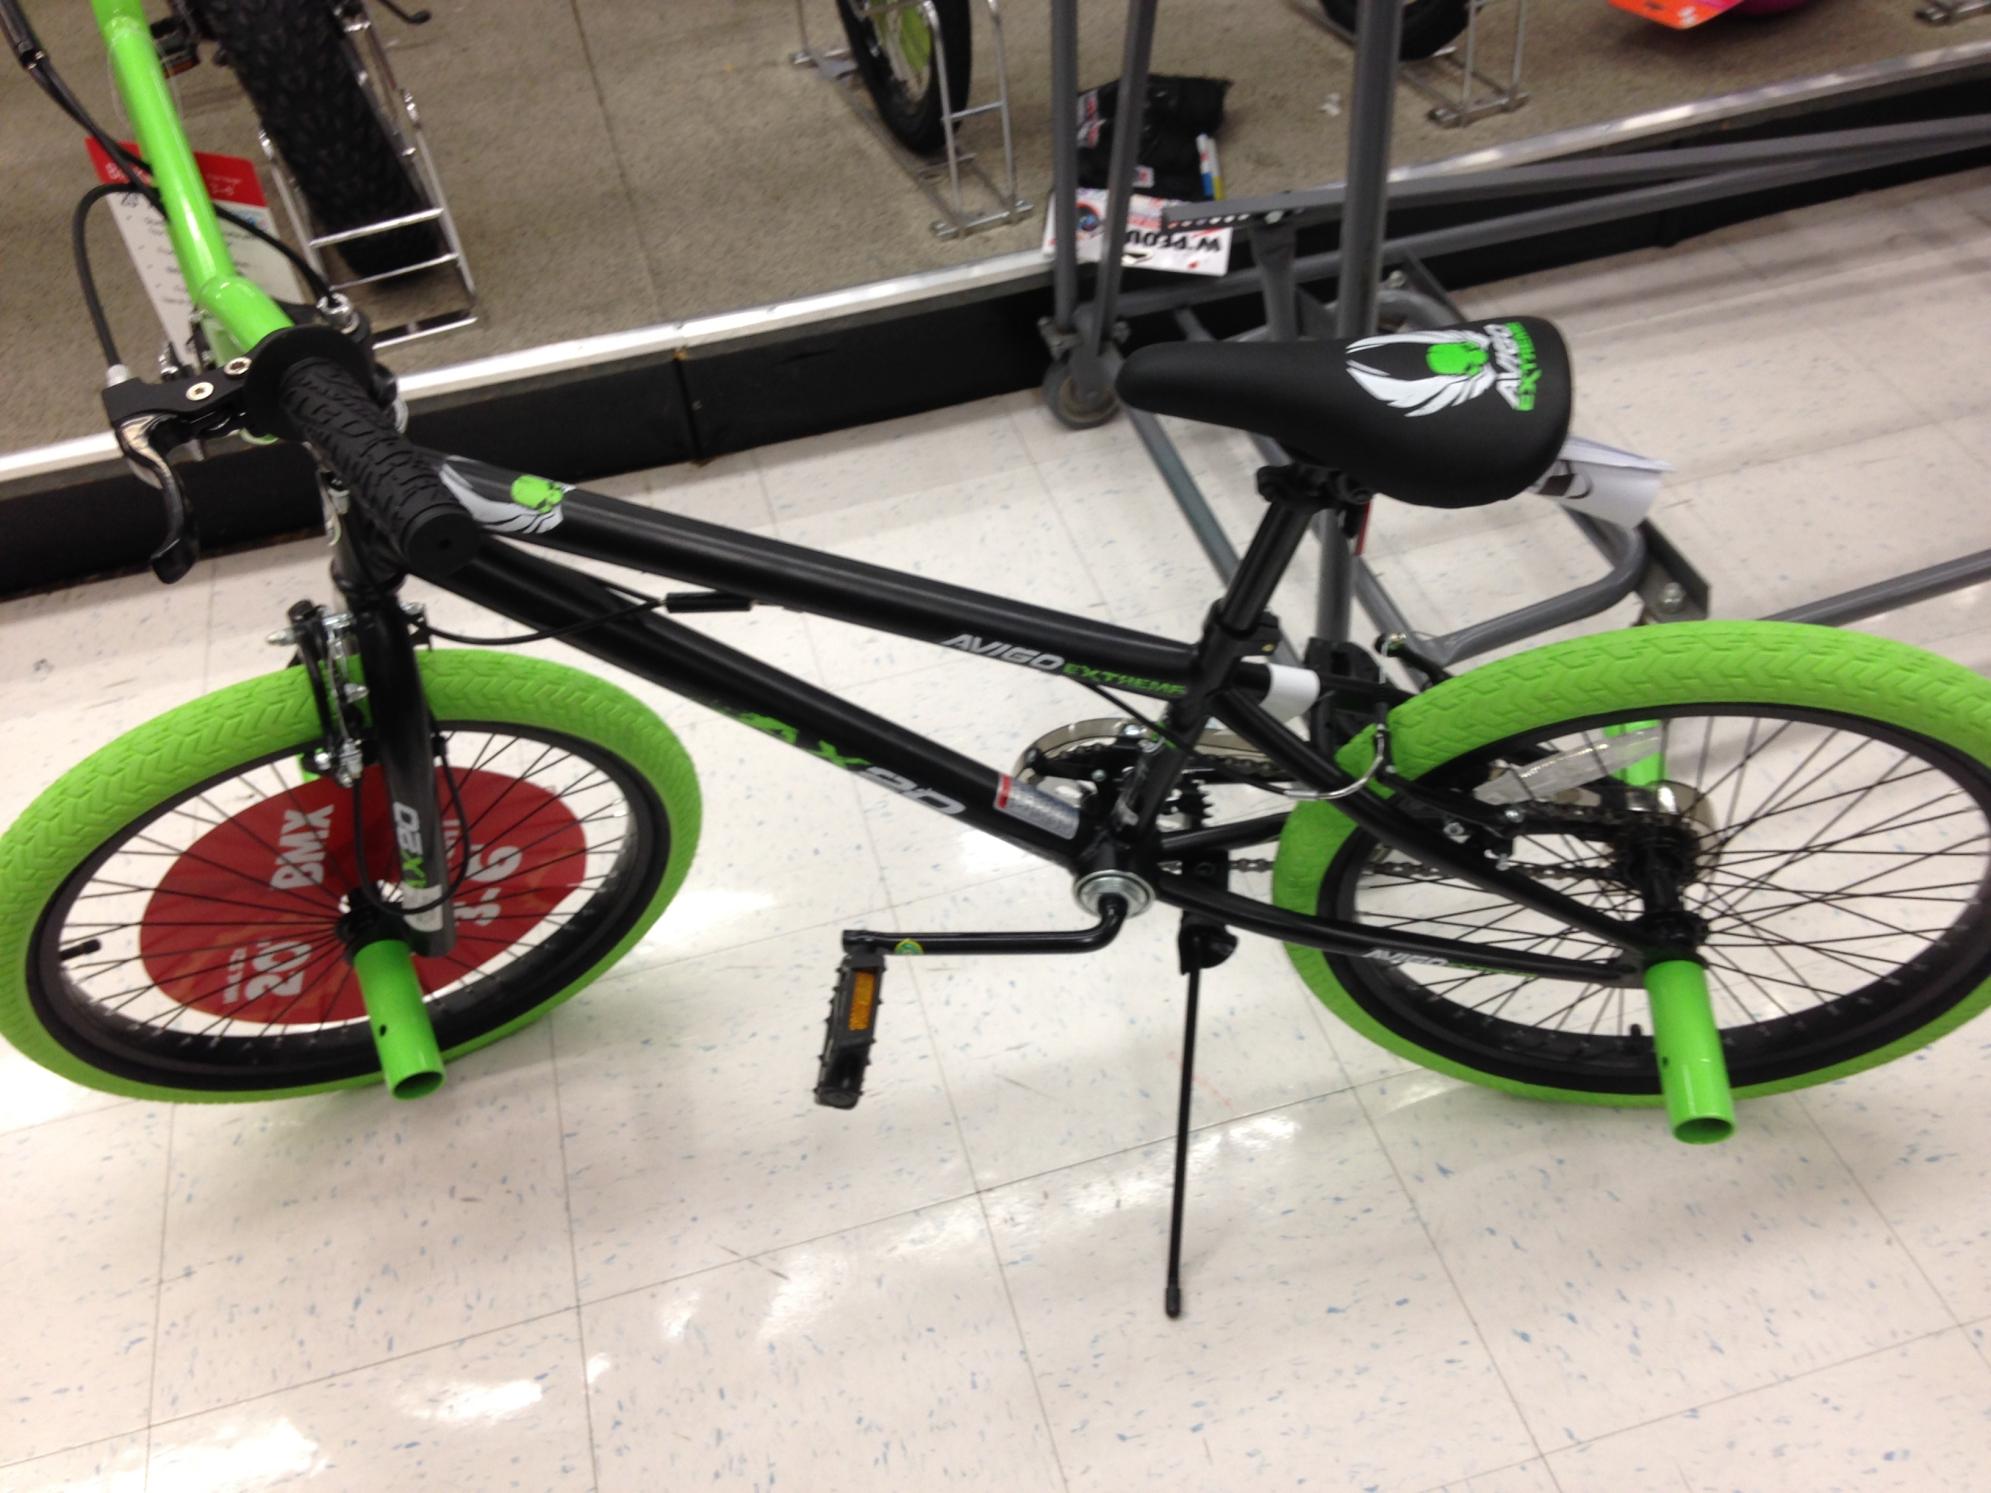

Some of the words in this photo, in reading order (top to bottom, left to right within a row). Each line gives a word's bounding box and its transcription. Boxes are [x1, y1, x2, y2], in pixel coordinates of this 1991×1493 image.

[942, 633, 1064, 671] AVIGO
[1062, 662, 1187, 695] EXTREME
[270, 804, 335, 890] BMX
